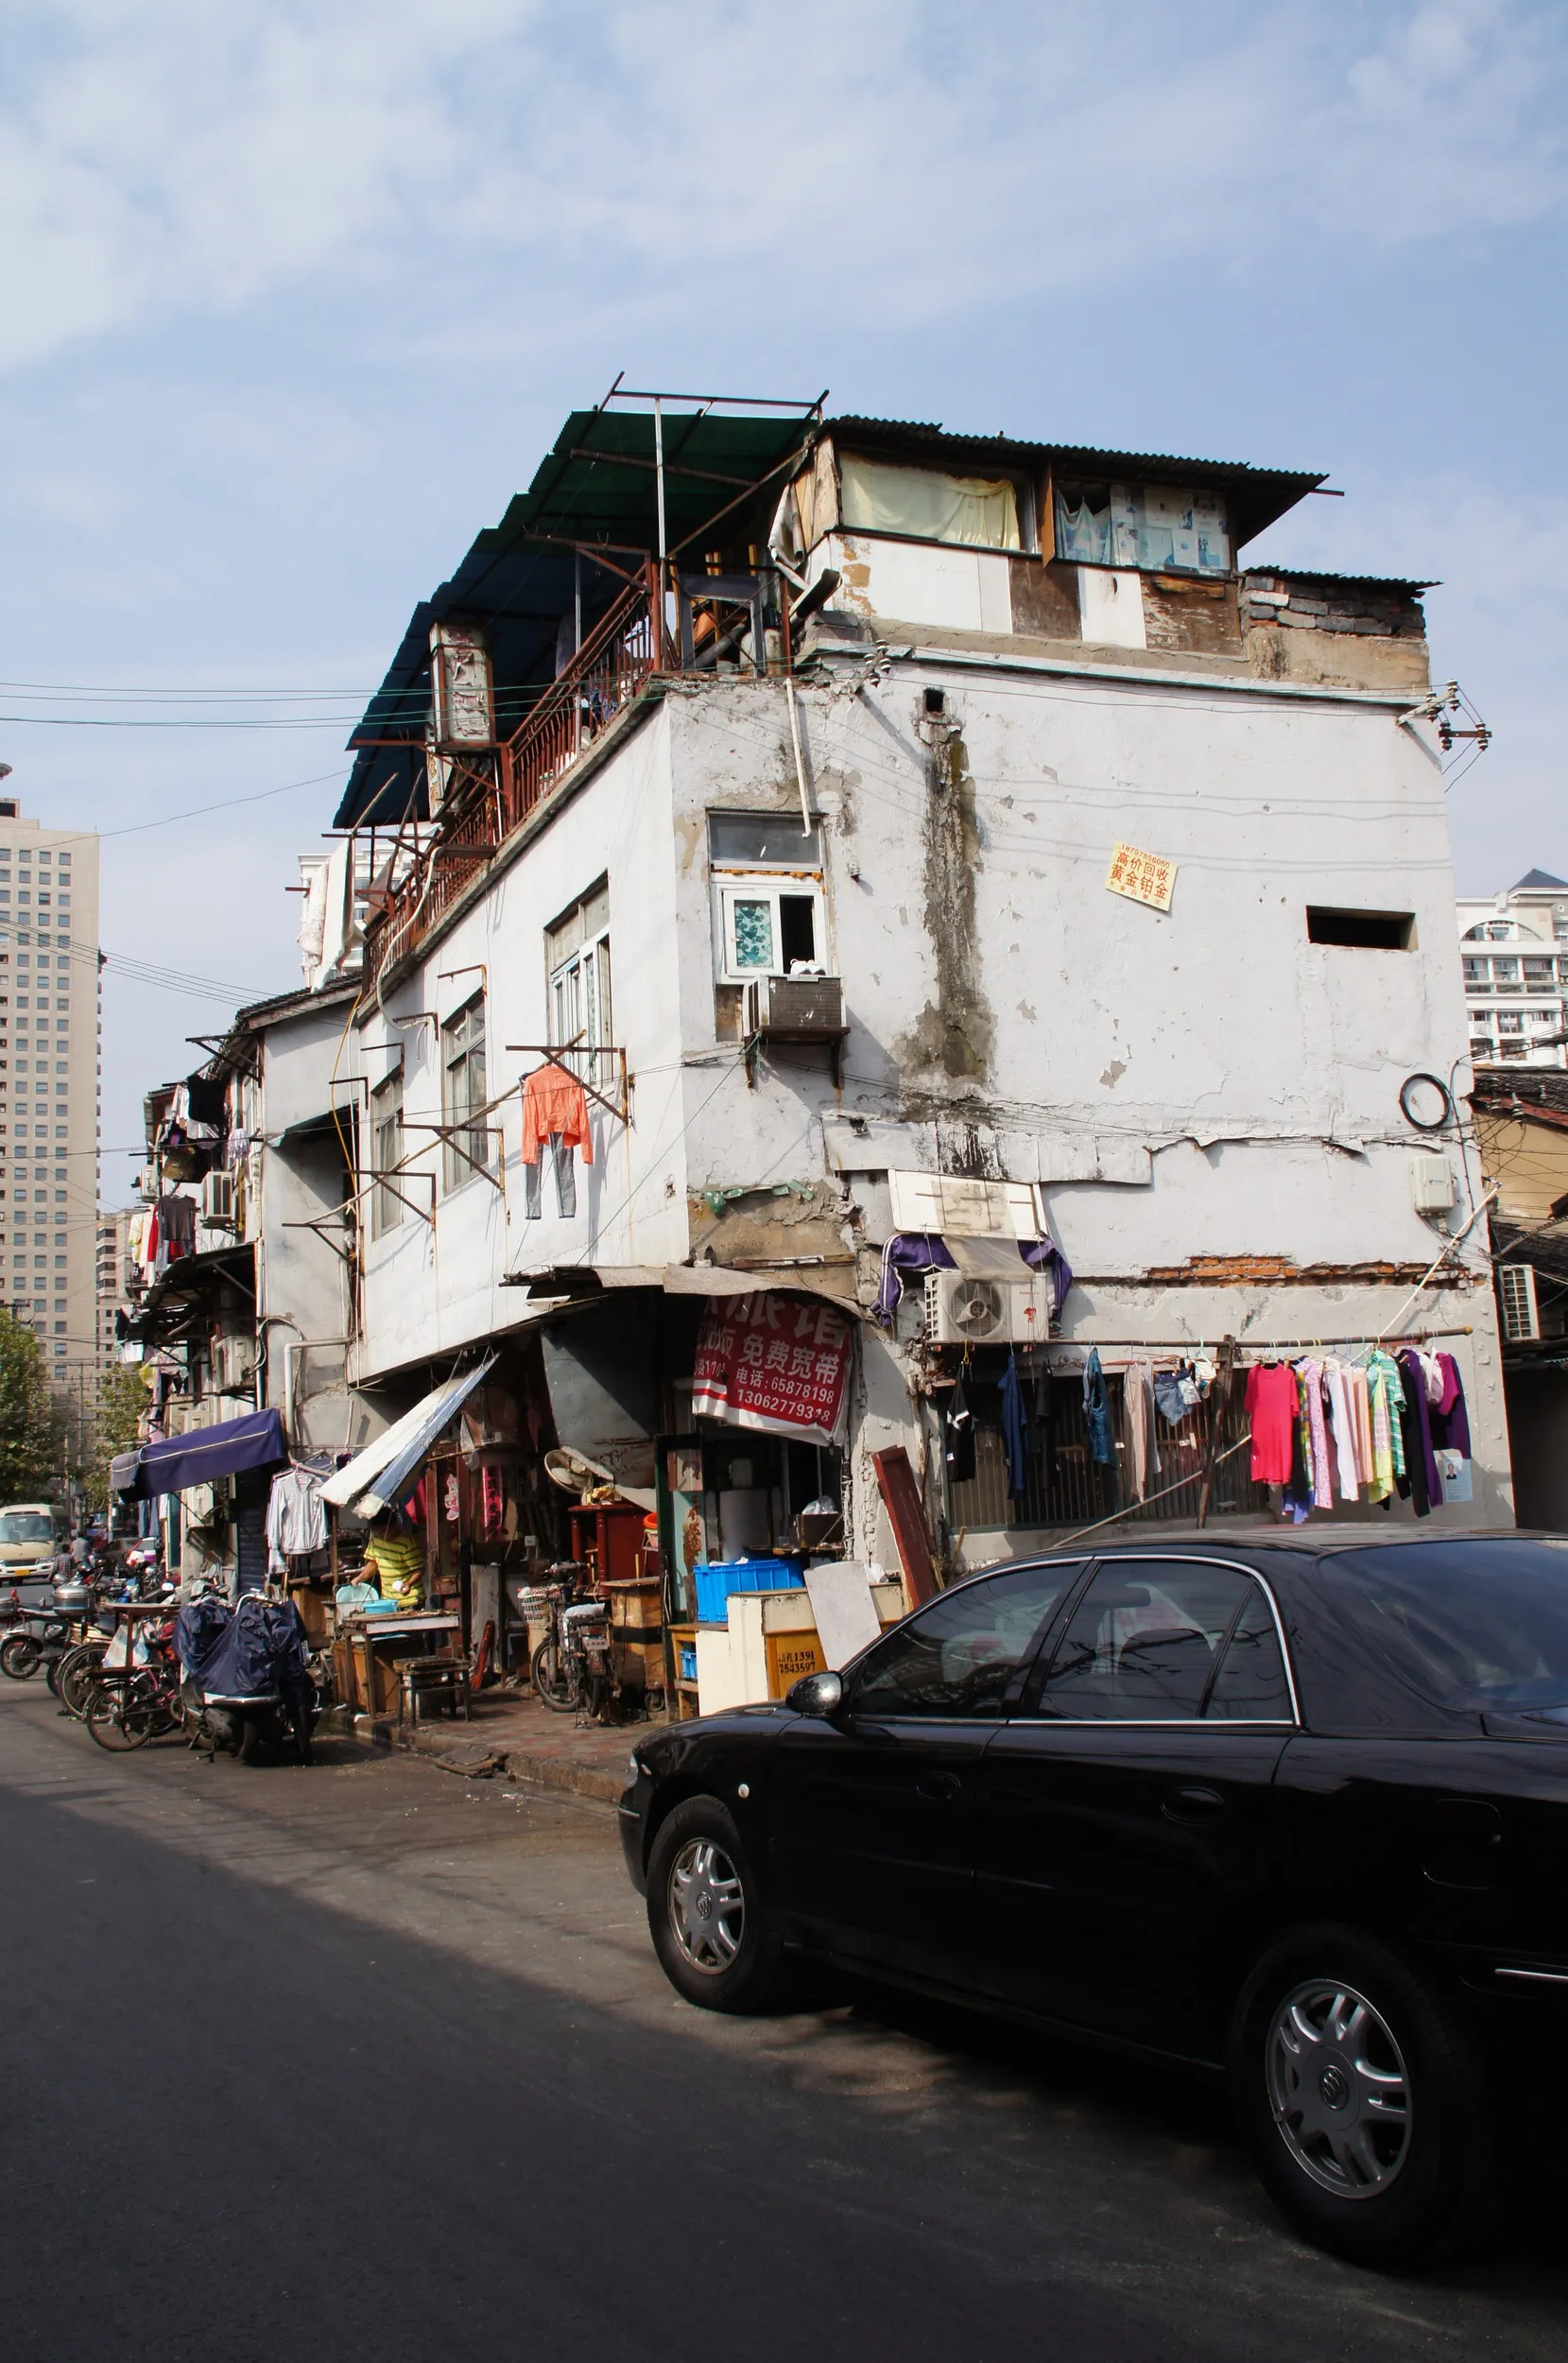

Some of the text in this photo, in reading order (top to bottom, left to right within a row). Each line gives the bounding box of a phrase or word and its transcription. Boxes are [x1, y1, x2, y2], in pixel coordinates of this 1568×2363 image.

[1110, 864, 1168, 900] 黄金铂金
[1116, 851, 1169, 882] 高价回收
[704, 1291, 847, 1349] 旅馆
[738, 1333, 839, 1385] 免费宽带
